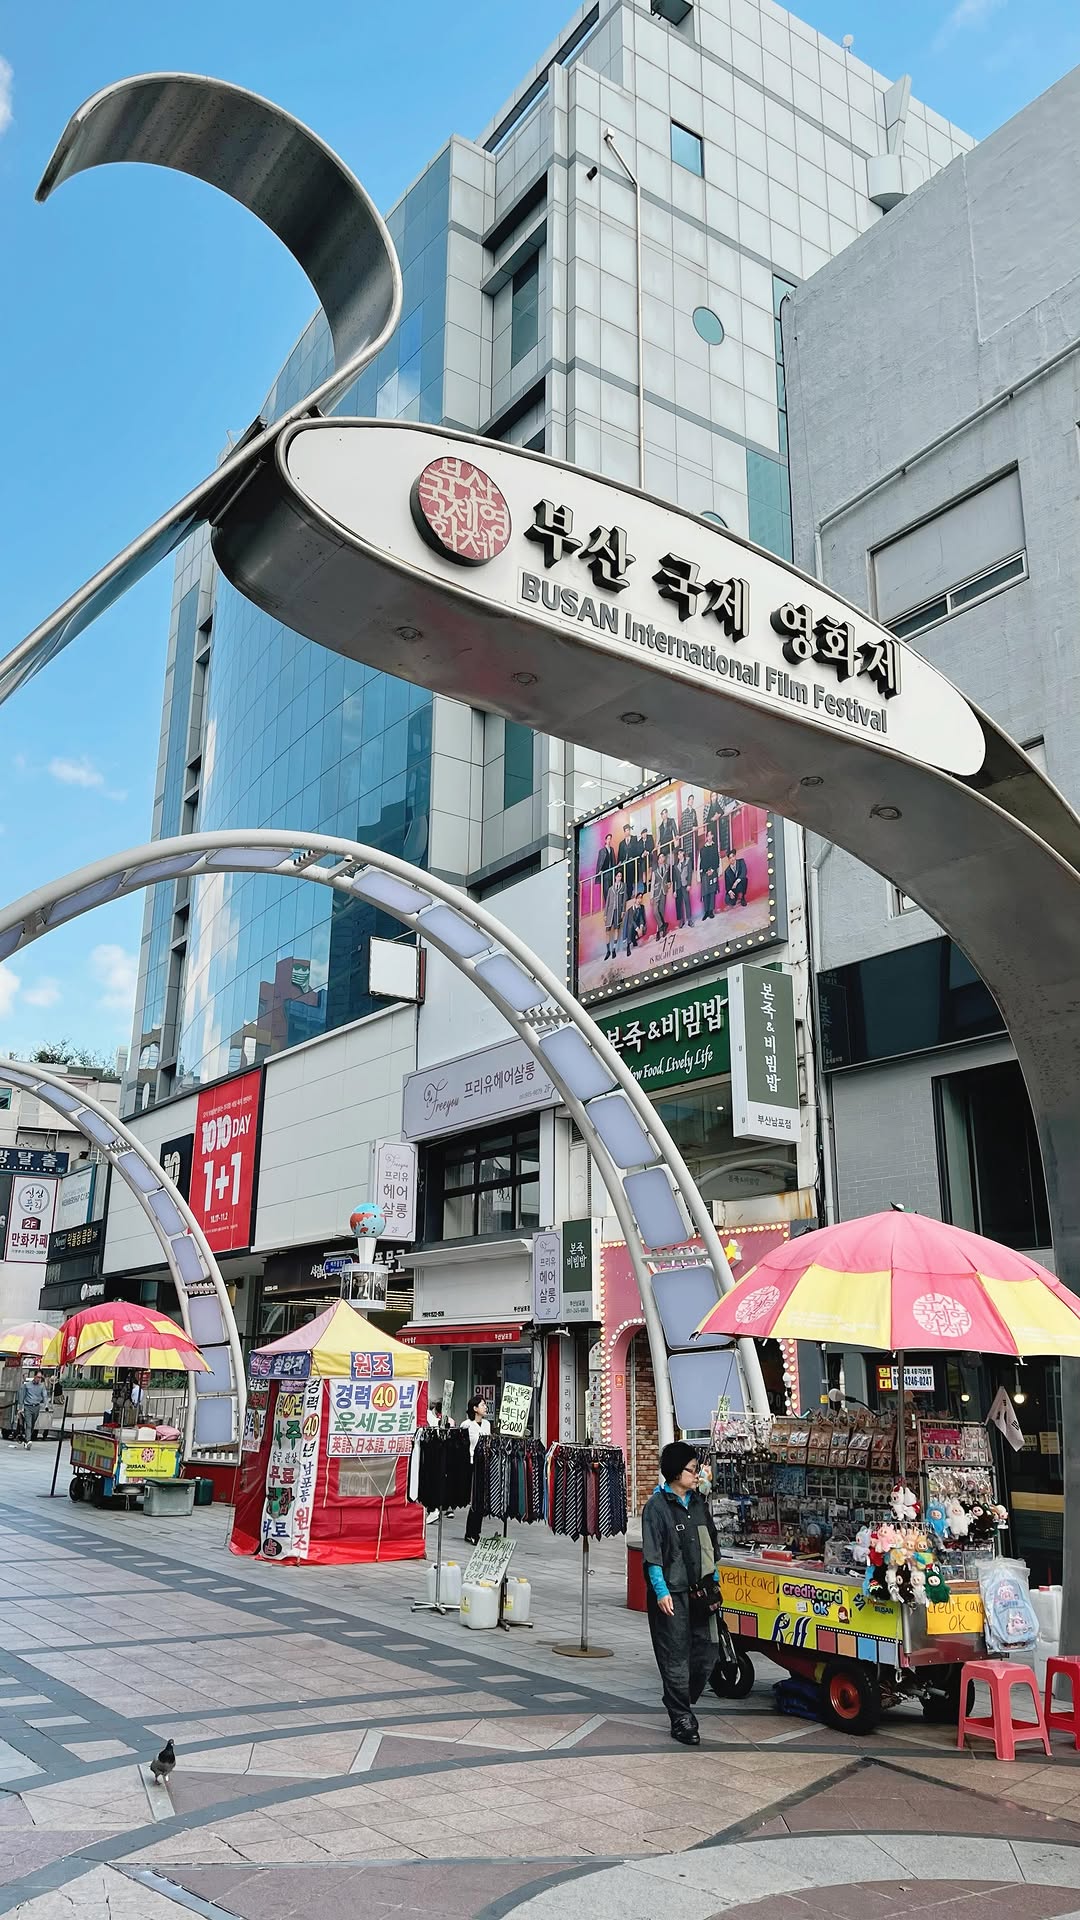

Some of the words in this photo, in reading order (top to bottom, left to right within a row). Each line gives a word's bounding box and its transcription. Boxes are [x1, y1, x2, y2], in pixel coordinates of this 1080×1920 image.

[524, 498, 636, 593] 부산
[652, 552, 750, 643] 국제
[770, 602, 902, 699] 영화제
[522, 572, 619, 634] BUSAN
[625, 612, 760, 687] International
[766, 665, 809, 705] Film
[813, 684, 888, 733] Festival
[607, 994, 728, 1056] 본죽&비빔밥
[760, 982, 782, 1093] 본죽&비빔밥
[643, 1056, 665, 1079] Food,
[665, 1049, 694, 1075] Lively
[694, 1043, 714, 1071] Life
[463, 1060, 536, 1099] 프리유헤어살롱
[231, 1113, 252, 1139] DAY
[757, 1114, 792, 1130] 부산남포점
[203, 1151, 242, 1212] 1+1
[384, 1171, 409, 1182] 프리유
[383, 1184, 408, 1201] 헤어
[382, 1202, 408, 1219] 살롱
[24, 1219, 38, 1228] 2F
[11, 1232, 48, 1249] 만화카페
[569, 1241, 584, 1255] 본죽
[539, 1256, 556, 1267] 프리유
[566, 1254, 587, 1269] 비빔밥
[539, 1269, 556, 1285] 헤어
[539, 1287, 556, 1304] 살롱
[273, 1354, 305, 1376] 철학관
[354, 1353, 391, 1377] 원조
[334, 1411, 415, 1433] 운세궁합
[269, 1466, 295, 1486] 무료
[263, 1519, 290, 1539] 타로
[293, 1506, 310, 1551] 원조
[719, 1569, 749, 1586] redit
[751, 1577, 776, 1595] card
[735, 1588, 757, 1604] OK
[949, 1614, 971, 1632] OK
